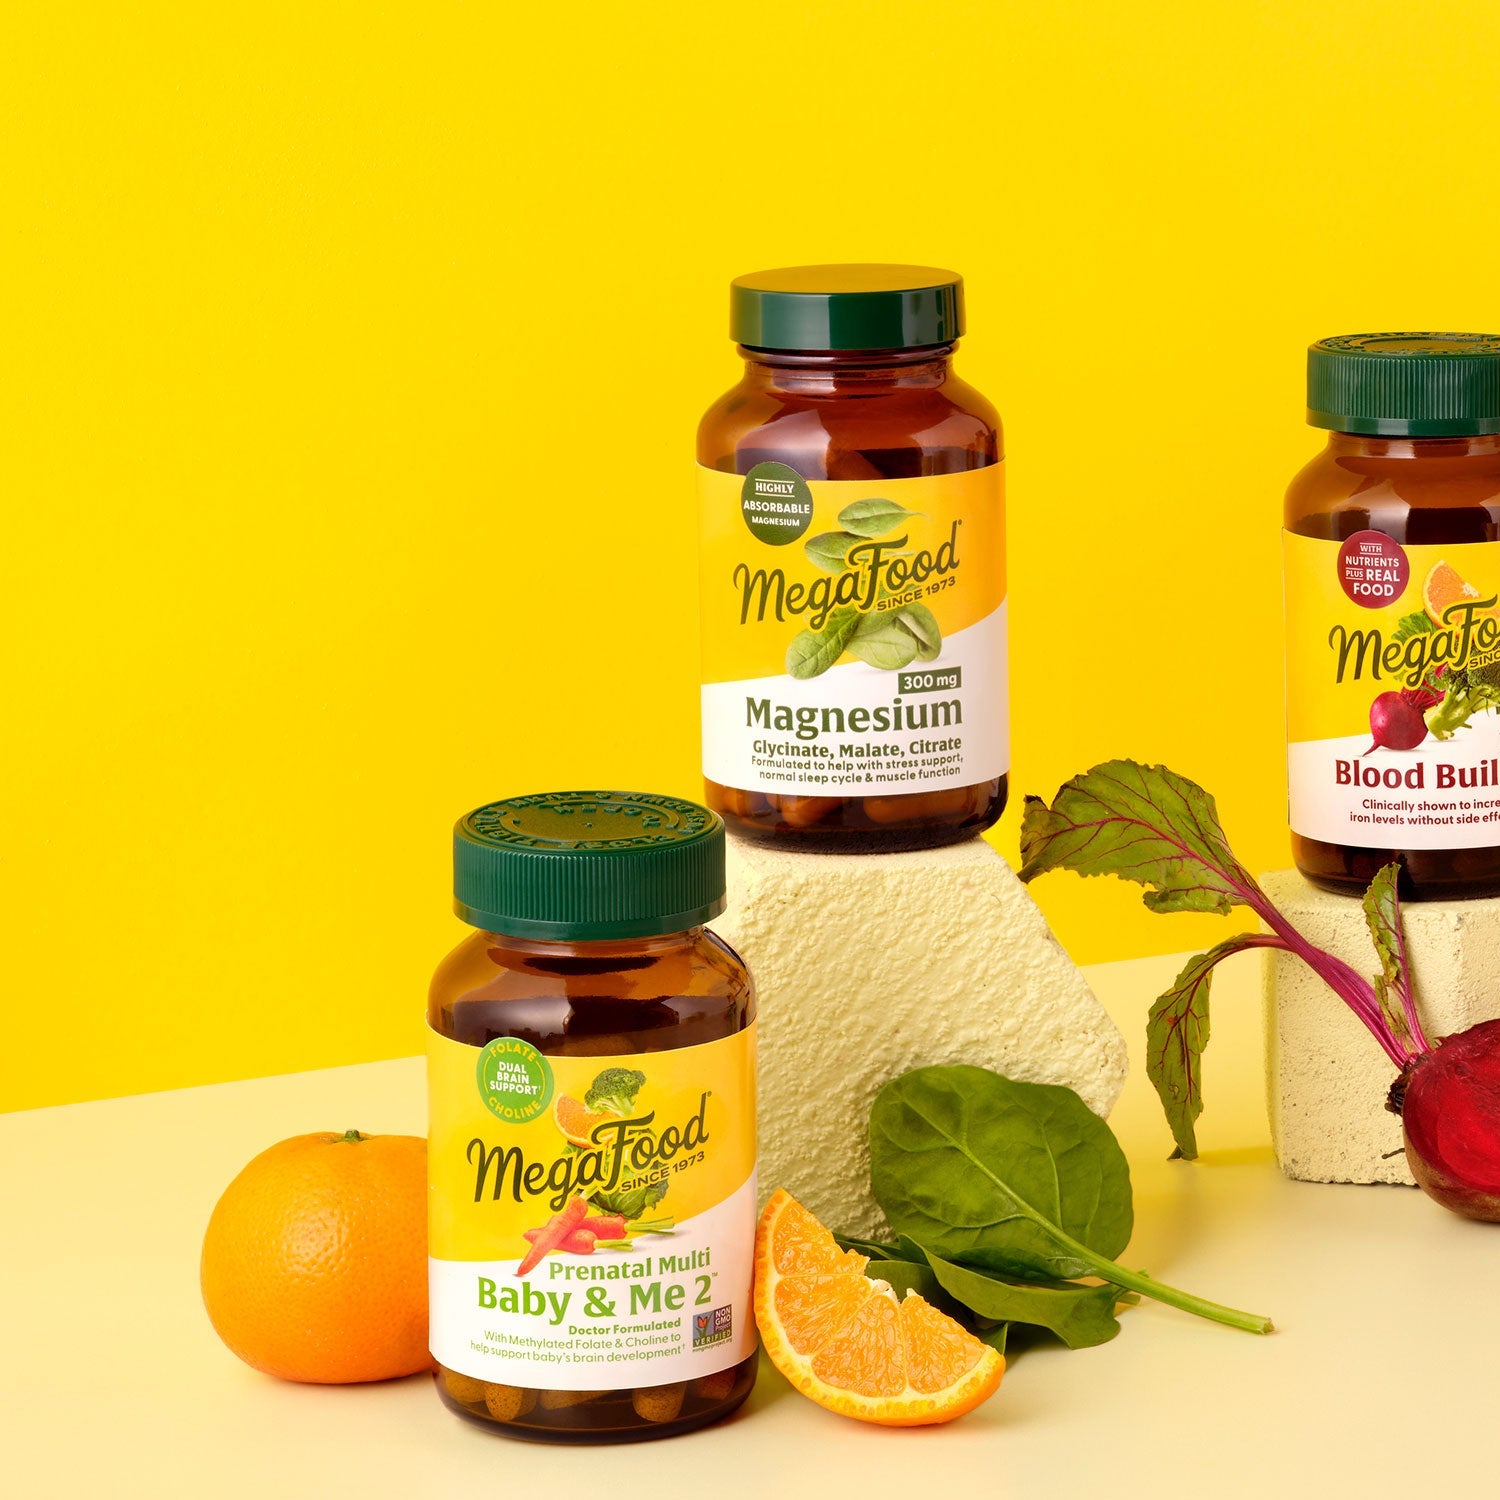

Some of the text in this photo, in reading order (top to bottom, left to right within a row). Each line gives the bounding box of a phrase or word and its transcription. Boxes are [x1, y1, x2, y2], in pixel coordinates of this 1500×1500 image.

[755, 482, 794, 494] HIGHLY
[743, 500, 810, 514] ABSORBABLE
[752, 516, 800, 526] MAGNESIUM
[1360, 545, 1382, 553] WITH
[1346, 556, 1399, 567] NUTRIENTS
[1346, 569, 1400, 582] PLUS REAL
[877, 576, 956, 611] SINCE 1973
[1353, 583, 1394, 596] FOOD
[904, 673, 957, 690] 300 mg
[746, 697, 962, 740] Magnesium
[753, 737, 961, 760] Glycinate, Malate, Citrate
[751, 753, 963, 772] Formulated to help with stress support,
[760, 766, 960, 785] normal sleep cycle & muscle function
[1336, 759, 1425, 789] Blood
[1362, 799, 1415, 813] Clinically
[1418, 801, 1456, 810] shown
[1459, 800, 1471, 809] to
[1350, 812, 1370, 822] iron
[1373, 814, 1404, 824] levels
[1407, 815, 1454, 825] without
[1456, 813, 1480, 823] side
[490, 1042, 537, 1062] FOLATE
[499, 1061, 526, 1074] DUAL
[497, 1072, 529, 1084] BRAIN
[489, 1097, 540, 1119] CHOLINE
[622, 1151, 705, 1192] SINCE 1973
[550, 1247, 710, 1280] Prenatal Multi
[477, 1277, 572, 1325] Baby
[584, 1287, 616, 1317] &
[630, 1283, 685, 1315] Me
[715, 1315, 730, 1325] GMO
[716, 1307, 730, 1318] NON
[568, 1318, 681, 1335] Doctor Formulated
[484, 1331, 681, 1349] With Methylated Folate & Choline to
[695, 1330, 730, 1345] VERIFIED
[470, 1341, 490, 1355] help
[491, 1347, 532, 1361] support
[533, 1351, 571, 1363] baby’s
[573, 1352, 605, 1362] brain
